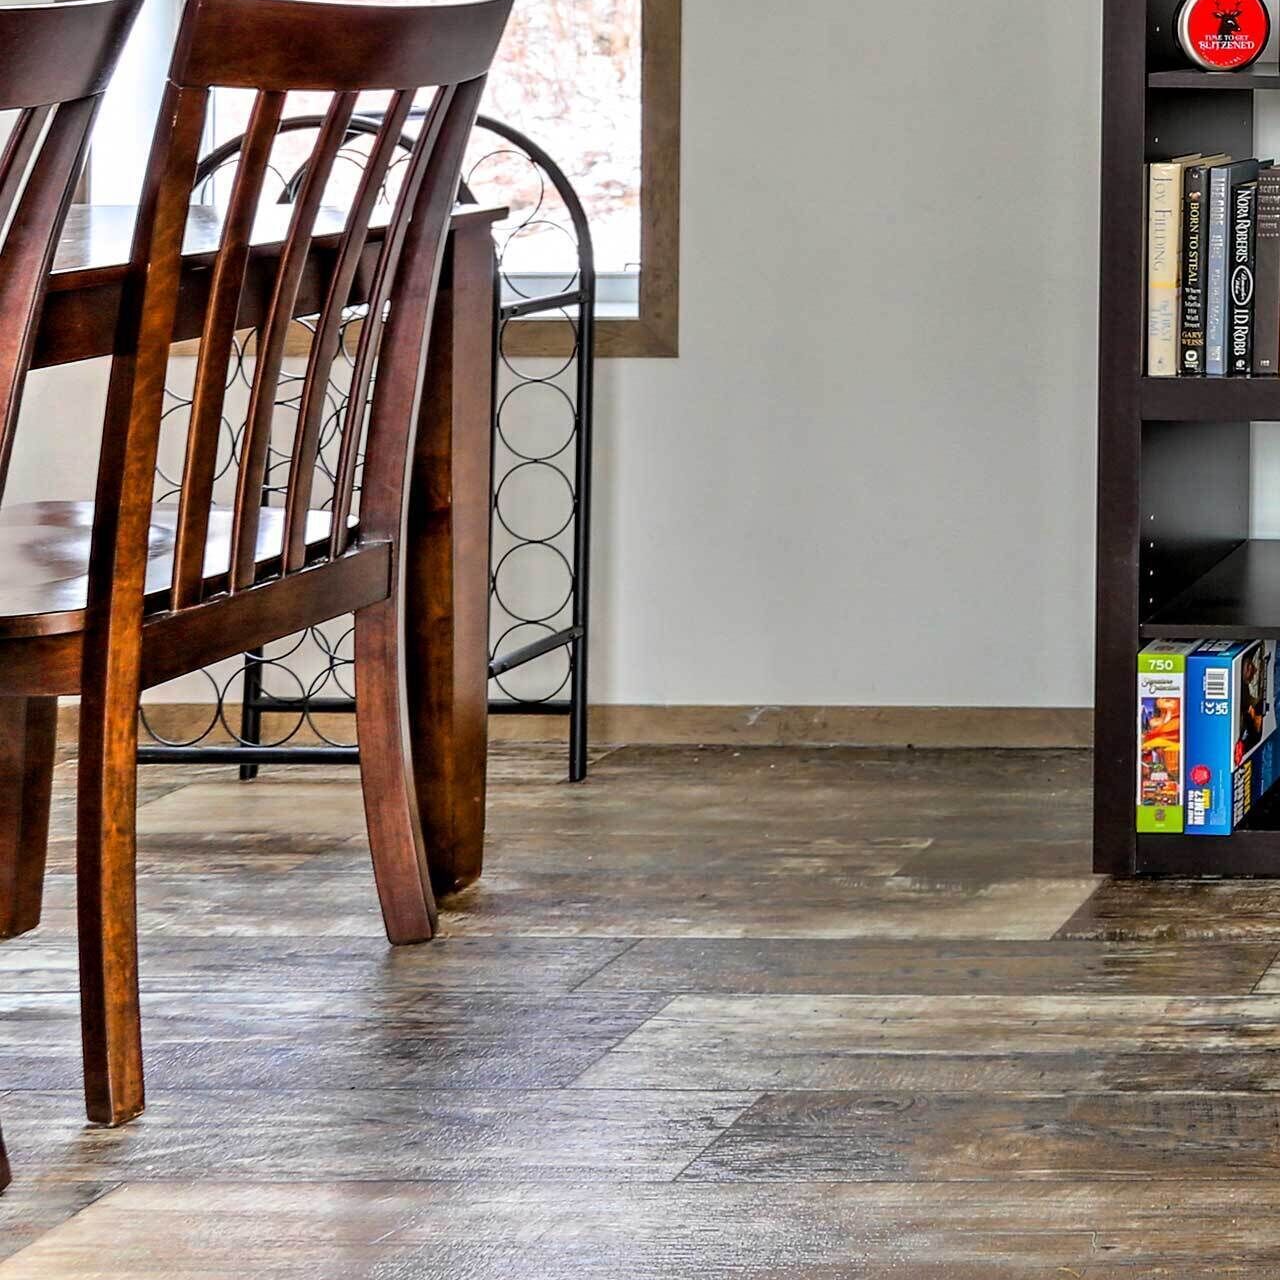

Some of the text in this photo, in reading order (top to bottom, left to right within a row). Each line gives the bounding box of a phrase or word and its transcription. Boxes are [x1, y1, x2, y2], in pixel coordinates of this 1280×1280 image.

[1198, 41, 1255, 49] BLITZENED
[1234, 189, 1252, 263] NORA ROBERTS
[1188, 202, 1199, 285] BORN TO STEAL
[1233, 326, 1249, 356] ROBB
[1148, 660, 1173, 670] 750
[1194, 790, 1205, 825] MEME?
